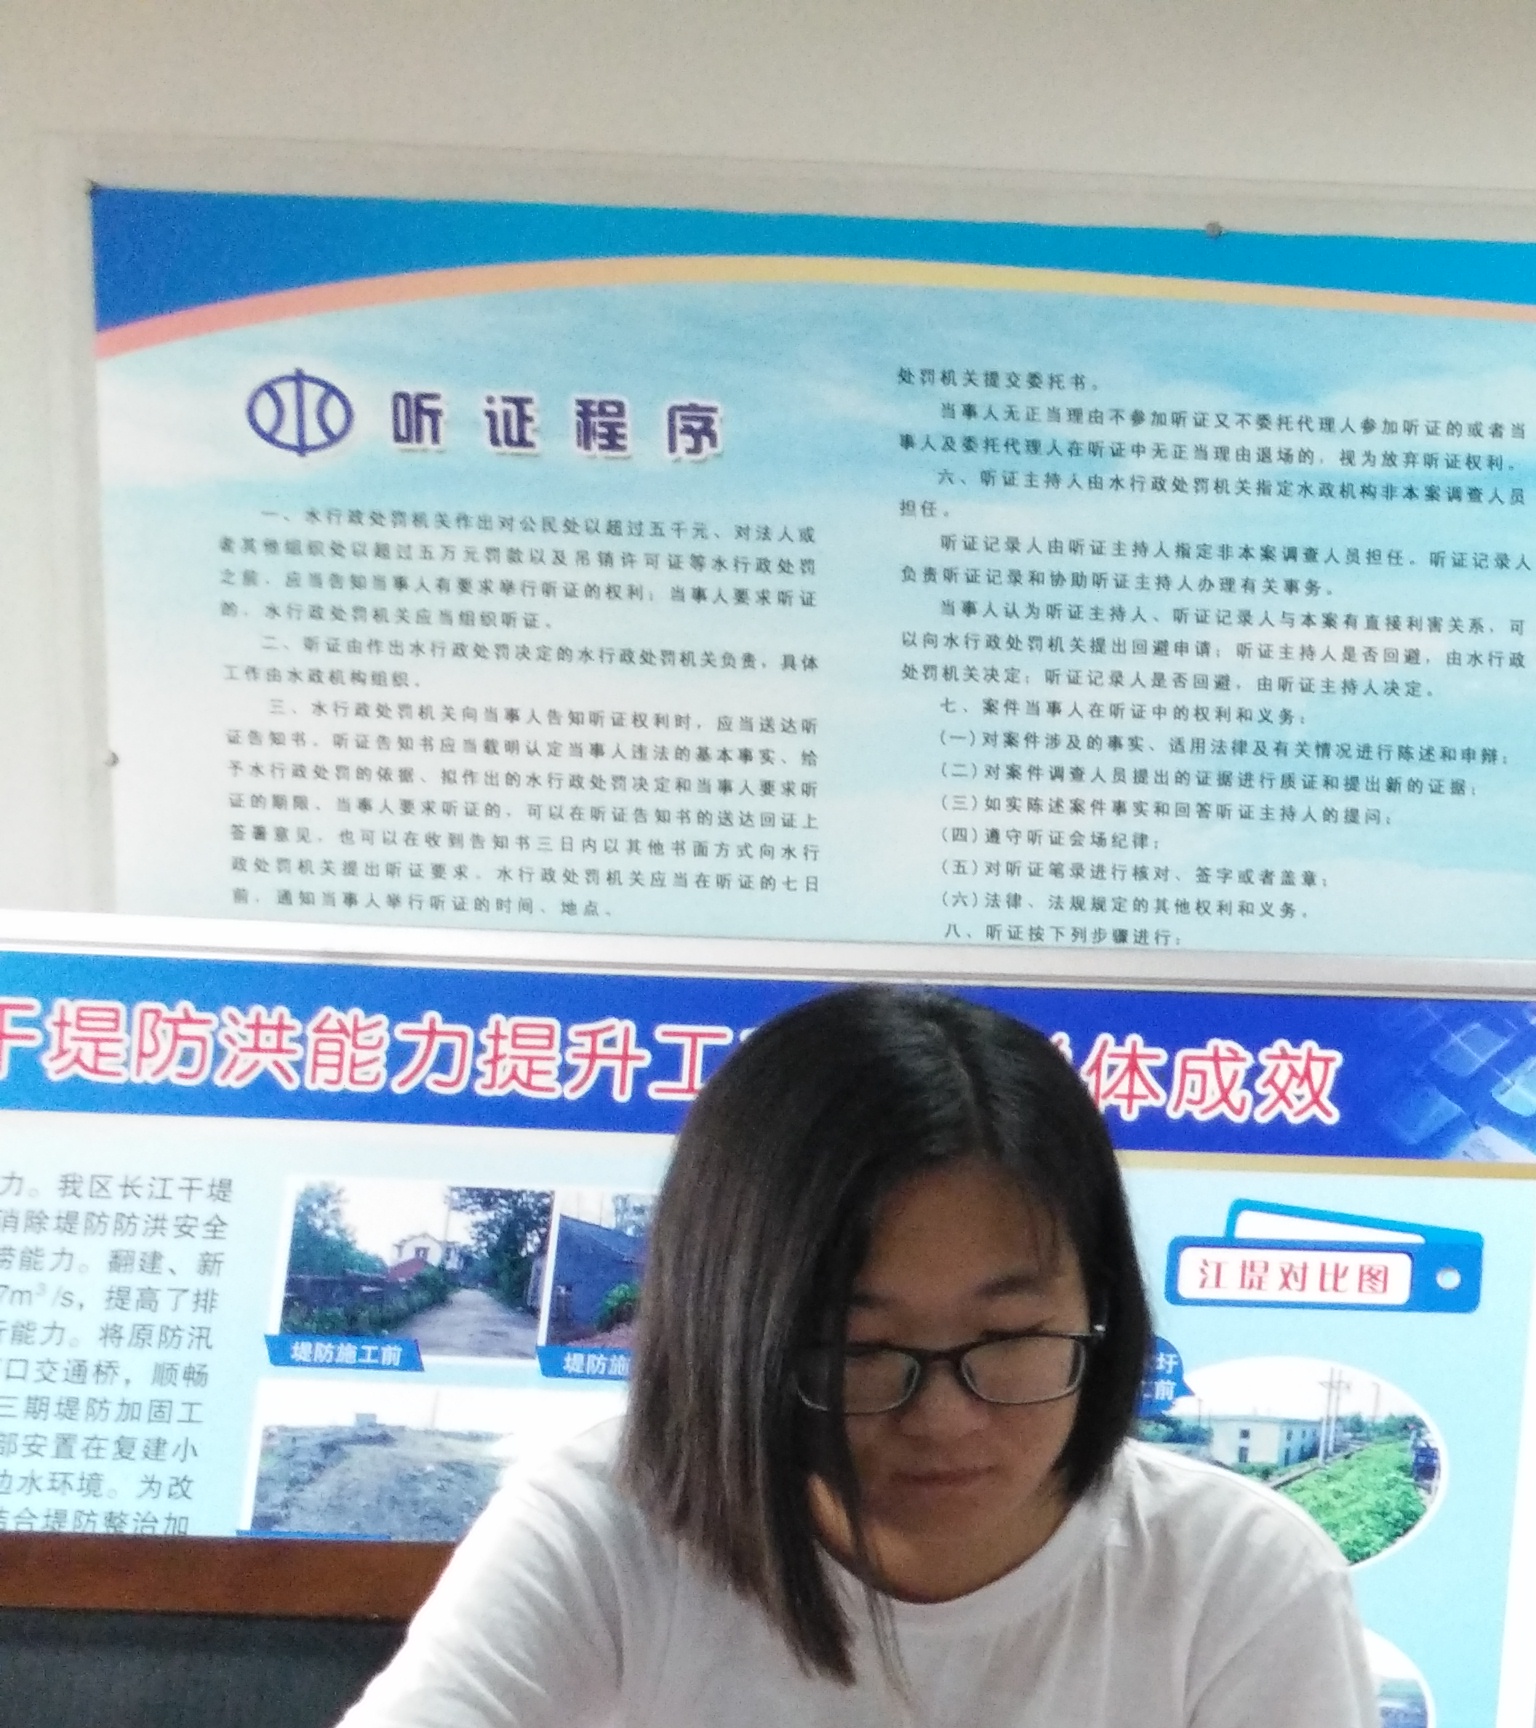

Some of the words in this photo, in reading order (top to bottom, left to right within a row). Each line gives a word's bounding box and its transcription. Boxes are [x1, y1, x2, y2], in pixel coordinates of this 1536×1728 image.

[898, 367, 1099, 391] 处罚机关提交委托书。
[390, 390, 722, 456] 听证程序
[899, 499, 949, 518] 担任。
[1055, 1035, 1342, 1122] 体成效
